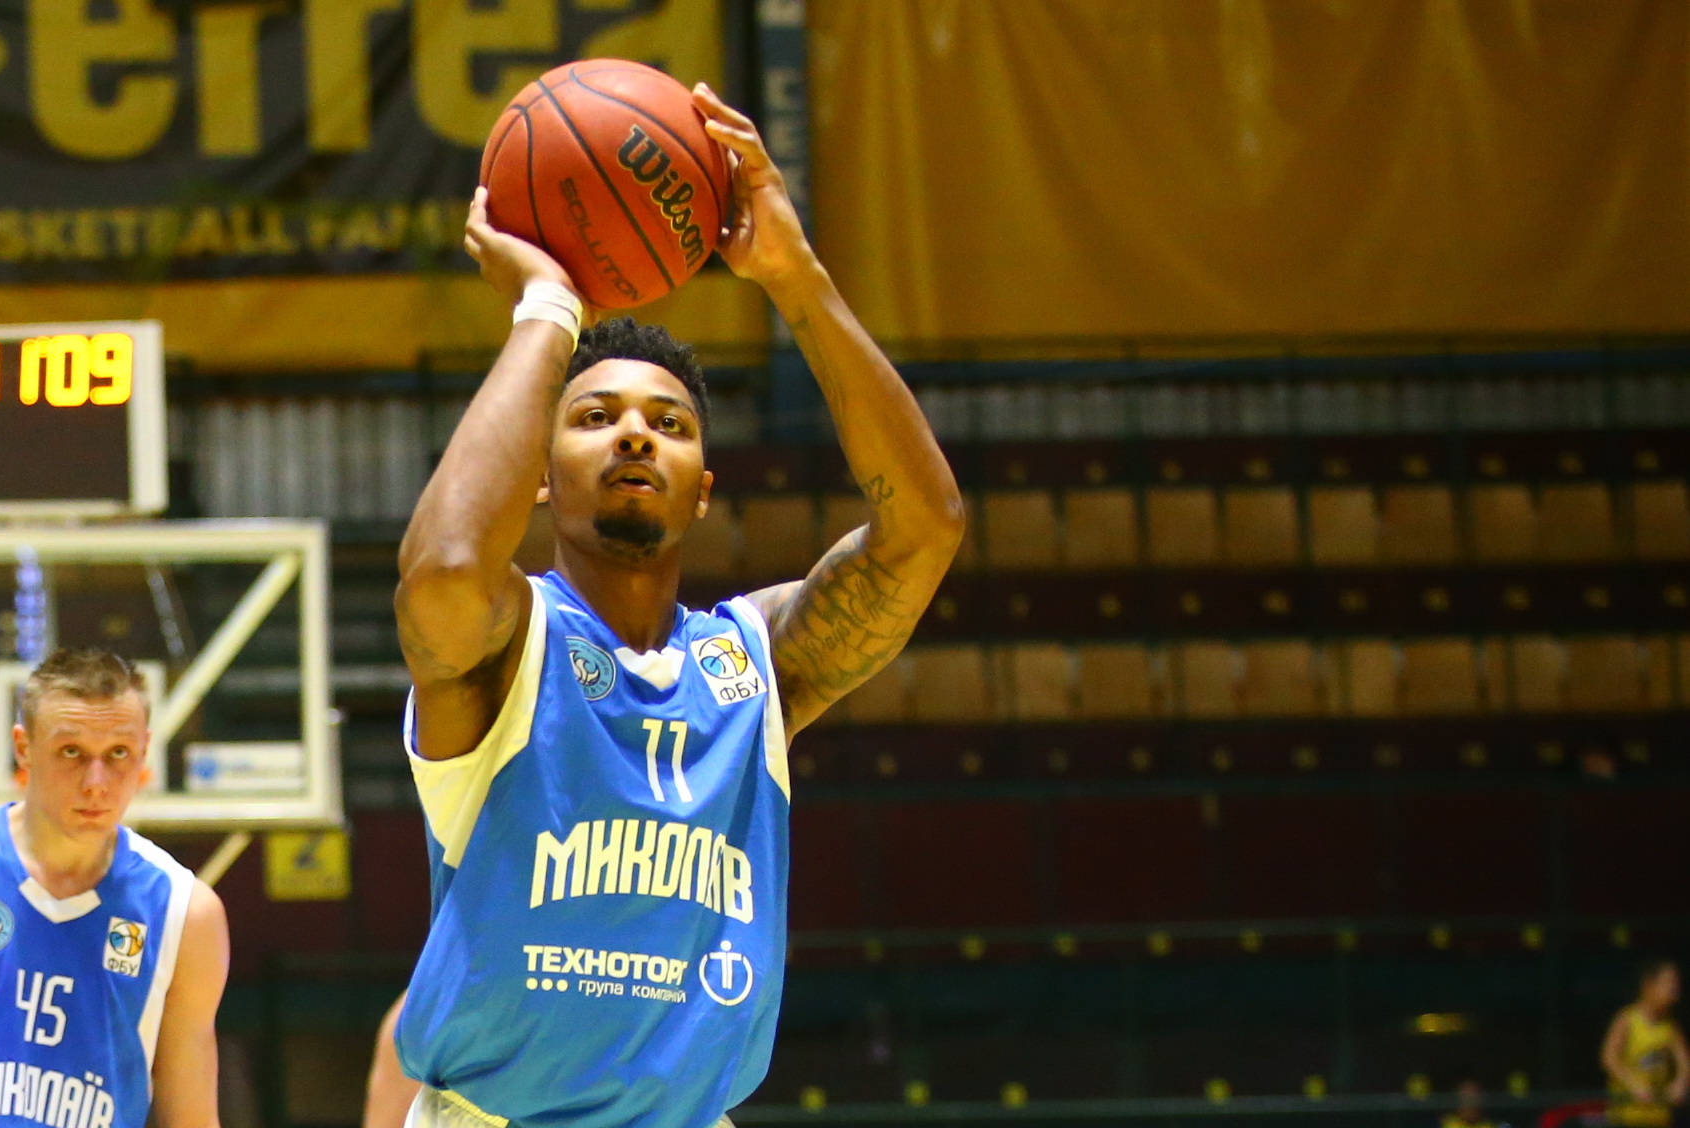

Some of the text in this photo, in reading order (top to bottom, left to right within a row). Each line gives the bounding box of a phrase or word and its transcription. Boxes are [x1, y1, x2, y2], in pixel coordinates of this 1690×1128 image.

[617, 124, 706, 270] Wilson
[719, 676, 760, 702] ФБУ
[642, 718, 693, 803] 11
[529, 818, 754, 925] МИКОЛАВ
[106, 957, 138, 976] ФБУ
[523, 944, 689, 986] ТЕХНОТОРГ
[578, 979, 624, 998] група
[15, 968, 74, 1047] 45
